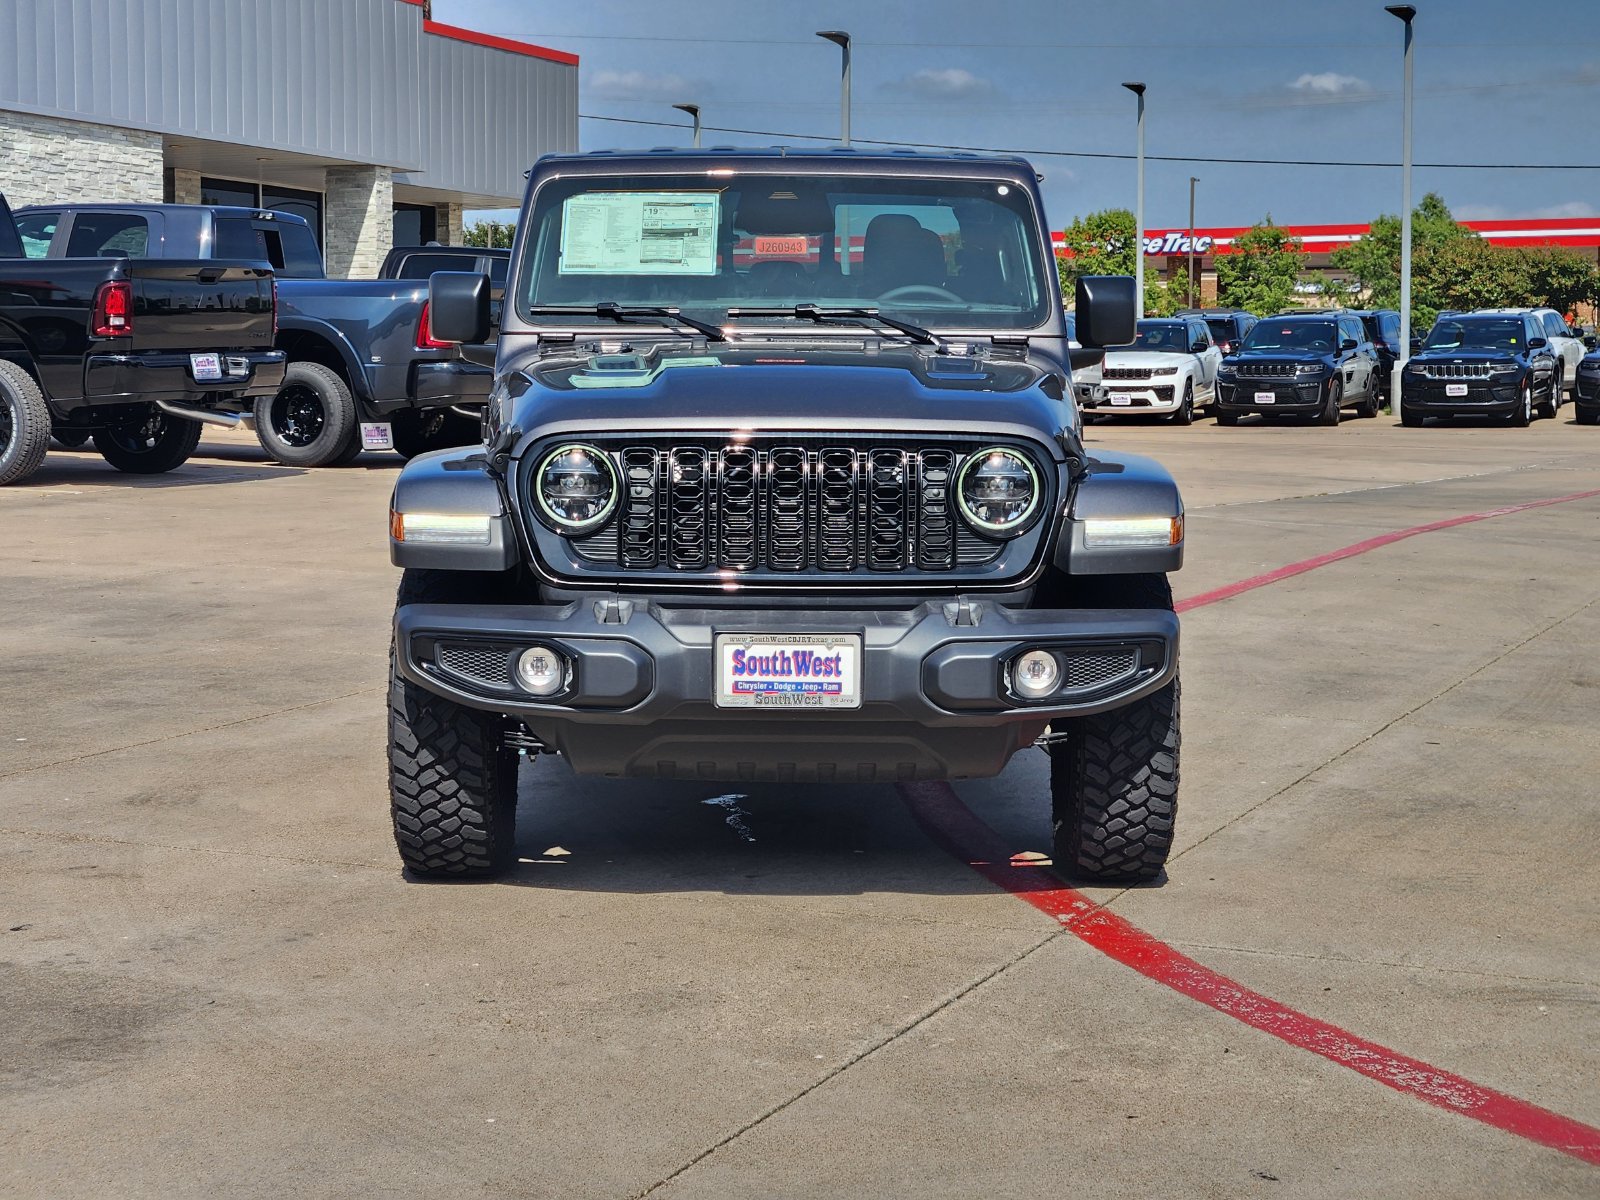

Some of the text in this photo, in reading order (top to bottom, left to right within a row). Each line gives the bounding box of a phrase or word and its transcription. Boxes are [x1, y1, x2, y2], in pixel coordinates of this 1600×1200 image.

[758, 241, 803, 253] J260943
[171, 292, 246, 309] RAM
[732, 648, 842, 677] SouthWest
[738, 682, 839, 692] Chrysler Dodge Jeep Ram
[754, 694, 824, 705] SouthWest
